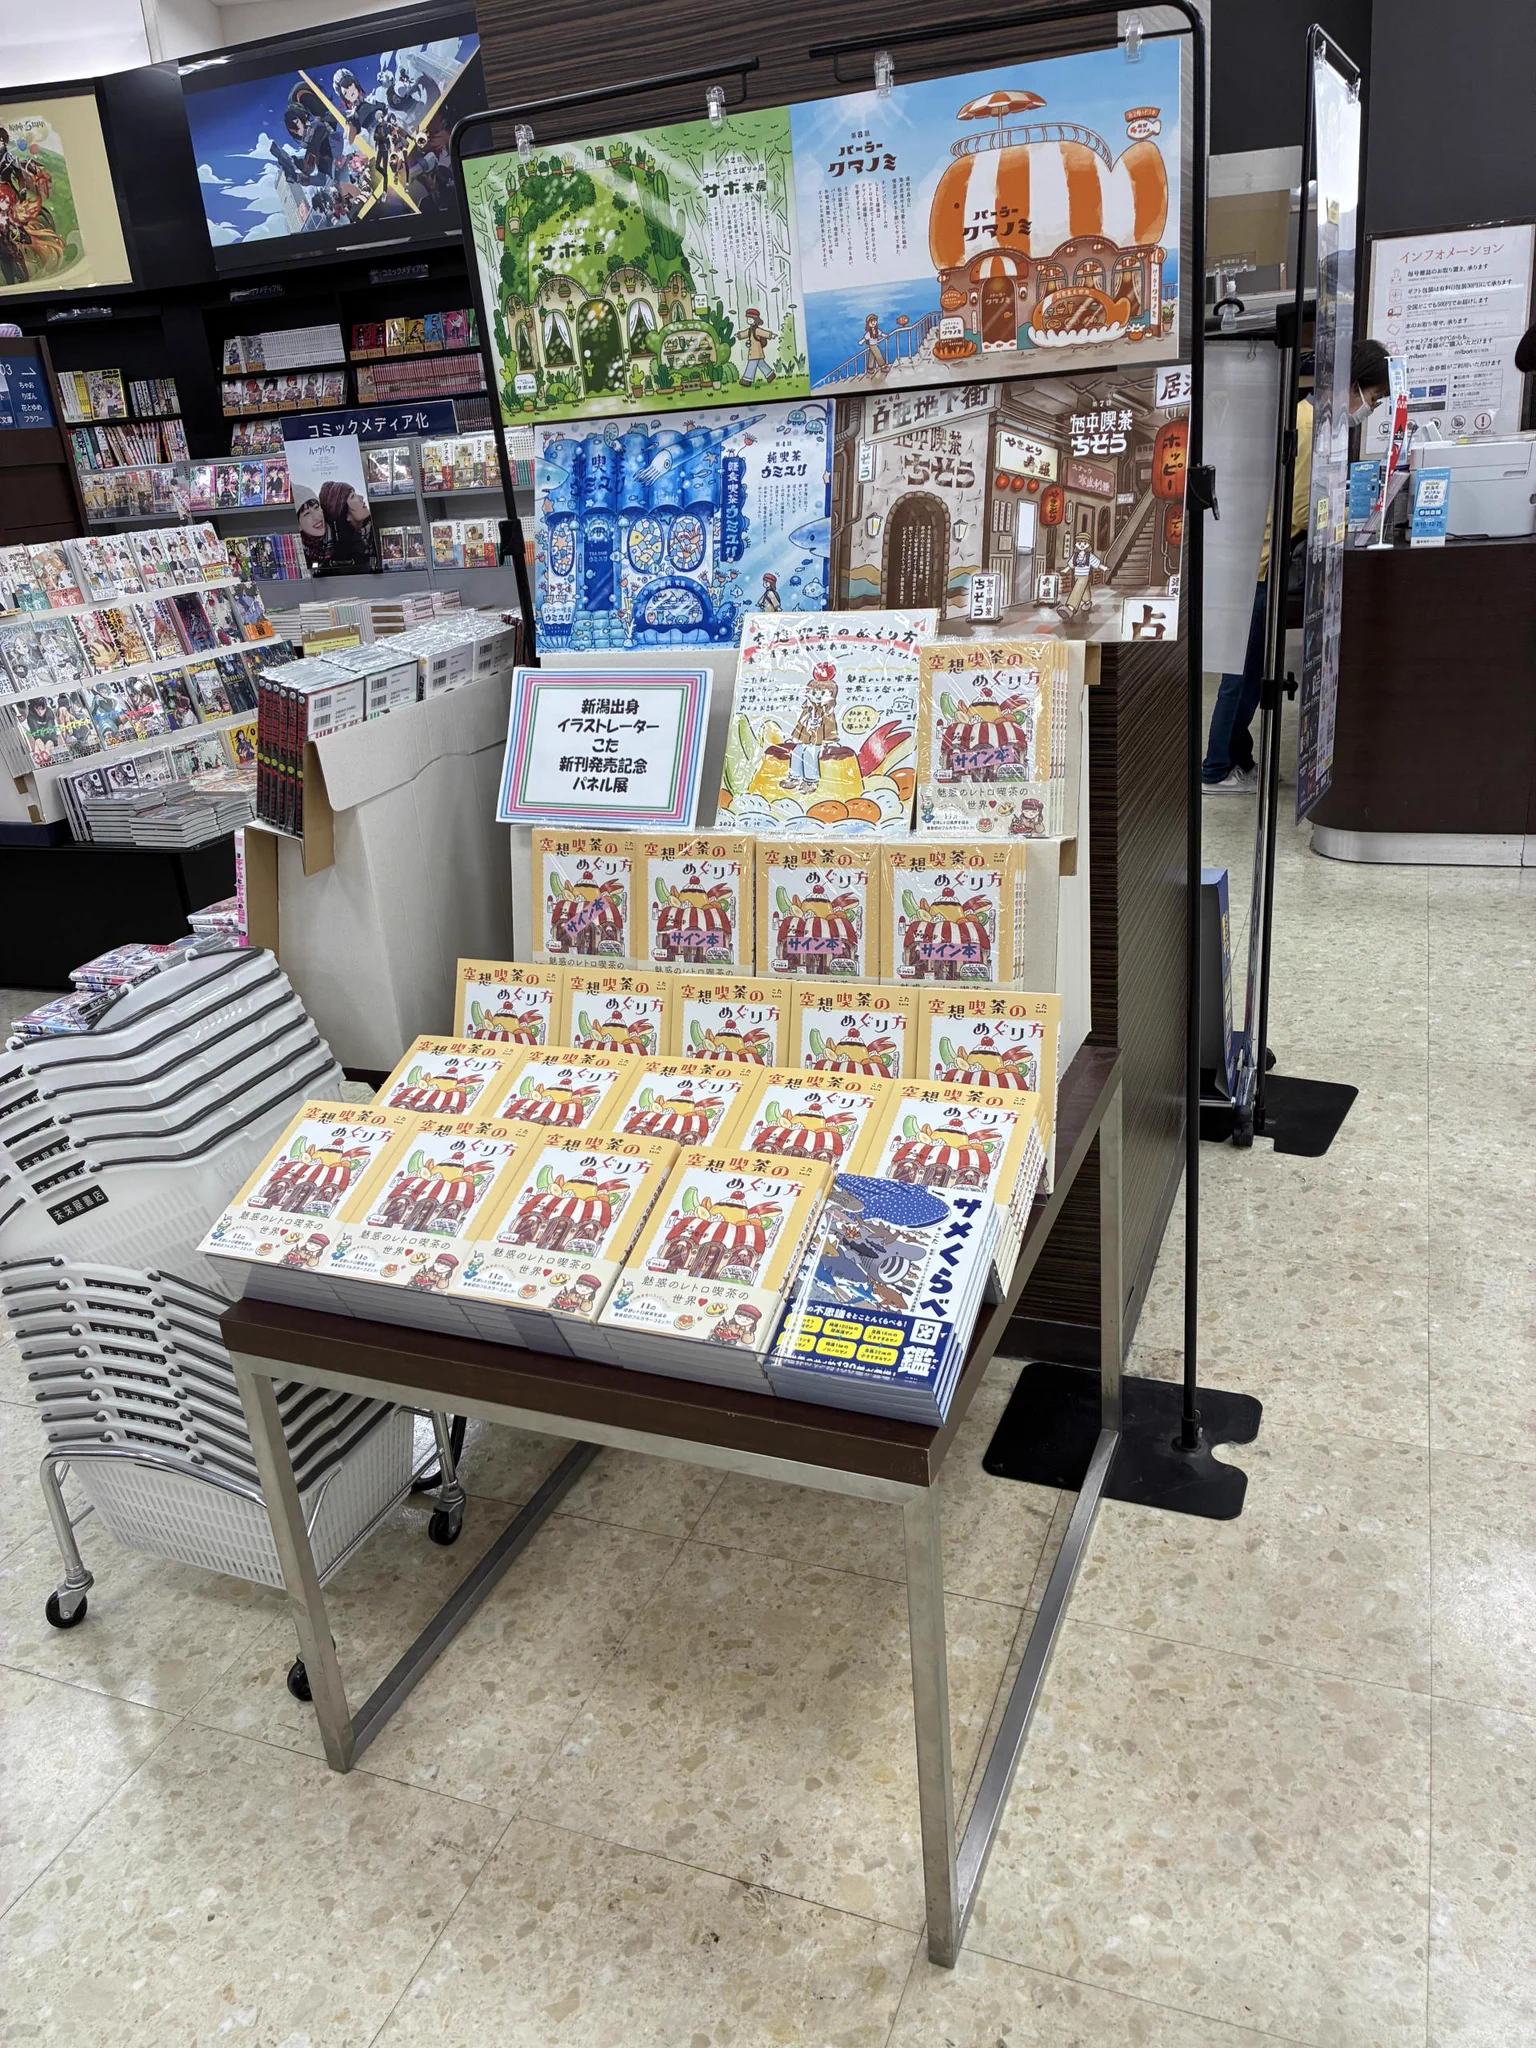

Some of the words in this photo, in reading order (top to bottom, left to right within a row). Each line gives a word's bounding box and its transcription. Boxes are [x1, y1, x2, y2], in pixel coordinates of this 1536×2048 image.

[838, 141, 883, 157] パーラー
[827, 153, 897, 178] クマノミ
[703, 179, 767, 198] サボ茶房
[972, 206, 1019, 221] パーラー
[962, 219, 1031, 241] クマノミ
[538, 241, 606, 261] サボ茶房
[1400, 244, 1505, 264] インフォメーション
[21, 404, 43, 412] 花とゆめ
[308, 412, 429, 438] コミックメディア化
[1068, 409, 1133, 435] 地中喫茶
[1005, 436, 1043, 456] やきとり
[1070, 433, 1127, 457] ちそう
[767, 450, 802, 464] 純喫茶
[1162, 433, 1183, 490] ホッピー
[761, 464, 807, 479] ウミユリ
[904, 453, 975, 489] ちそう
[1071, 464, 1093, 474] スナック
[569, 475, 626, 497] ウミユリ
[1048, 487, 1059, 522] やきとり
[973, 578, 985, 616] ちそう
[985, 578, 995, 616] 地中喫茶
[545, 613, 572, 622] ウミユリ
[928, 649, 1023, 675] 空想喫茶の
[972, 670, 1041, 690] めぐり方
[581, 698, 640, 715] 新潟出身
[557, 718, 660, 734] イラストレーター
[592, 738, 620, 753] こた
[559, 756, 648, 774] 新刊発売記念
[953, 748, 1010, 769] サイン本
[572, 777, 629, 793] パネル展
[967, 799, 989, 811] 世界
[539, 837, 618, 857] 空想喫茶の
[644, 841, 726, 862] 空想喫茶の
[576, 856, 633, 875] めぐり方
[764, 849, 852, 870] 空想喫茶の
[890, 850, 985, 873] 空想喫茶の
[682, 861, 742, 879] めぐり方
[805, 870, 869, 888] めぐり方
[934, 871, 1003, 890] めぐり方
[566, 897, 604, 934] サイン本
[671, 933, 720, 947] サイン本
[788, 938, 839, 952] サイン本
[921, 943, 977, 959] サイン本
[549, 956, 625, 969] 魅惑のレトロ喫茶の
[463, 968, 540, 987] 空想喫茶の
[570, 976, 650, 996] 空想喫茶の
[497, 988, 555, 1005] めぐり方
[680, 985, 764, 1005] 空想喫茶の
[800, 992, 890, 1012] 空想喫茶の
[605, 997, 665, 1015] めぐり方
[718, 1005, 780, 1024] めぐり方
[928, 999, 1027, 1020] 空想喫茶の
[840, 1013, 908, 1033] めぐり方
[973, 1020, 1046, 1042] めぐり方
[418, 1040, 497, 1057] 空想喫茶の
[527, 1049, 611, 1067] 空想喫茶の
[443, 1056, 506, 1072] めぐり方
[645, 1060, 731, 1078] 空想喫茶の
[557, 1068, 621, 1082] めぐり方
[768, 1072, 862, 1092] 空想喫茶の
[676, 1077, 744, 1094] めぐり方
[804, 1091, 877, 1110] めぐり方
[901, 1085, 1004, 1107] 空想喫茶の
[303, 1106, 387, 1126] 空想喫茶の
[943, 1106, 1021, 1127] めぐり方
[331, 1125, 396, 1144] めぐり方
[418, 1119, 508, 1137] 空想喫茶の
[450, 1137, 519, 1156] めぐり方
[545, 1133, 641, 1155] 空想喫茶の
[581, 1156, 653, 1176] めぐり方
[687, 1153, 790, 1177] 空想喫茶の
[725, 1178, 806, 1198] めぐり方
[53, 1189, 105, 1221] 未来屋書店
[238, 1210, 324, 1231] 魅惑のレトロ喫茶の
[260, 1225, 281, 1236] 世界
[359, 1229, 451, 1249] 魅惑のレトロ喫茶の
[383, 1246, 405, 1257] 世界
[491, 1247, 592, 1271] 魅惑のレトロ喫茶の
[919, 1198, 983, 1318] サメくらべ
[519, 1264, 542, 1277] 世界
[641, 1275, 749, 1300] 魅惑のレトロ喫茶の
[672, 1292, 698, 1307] 世界
